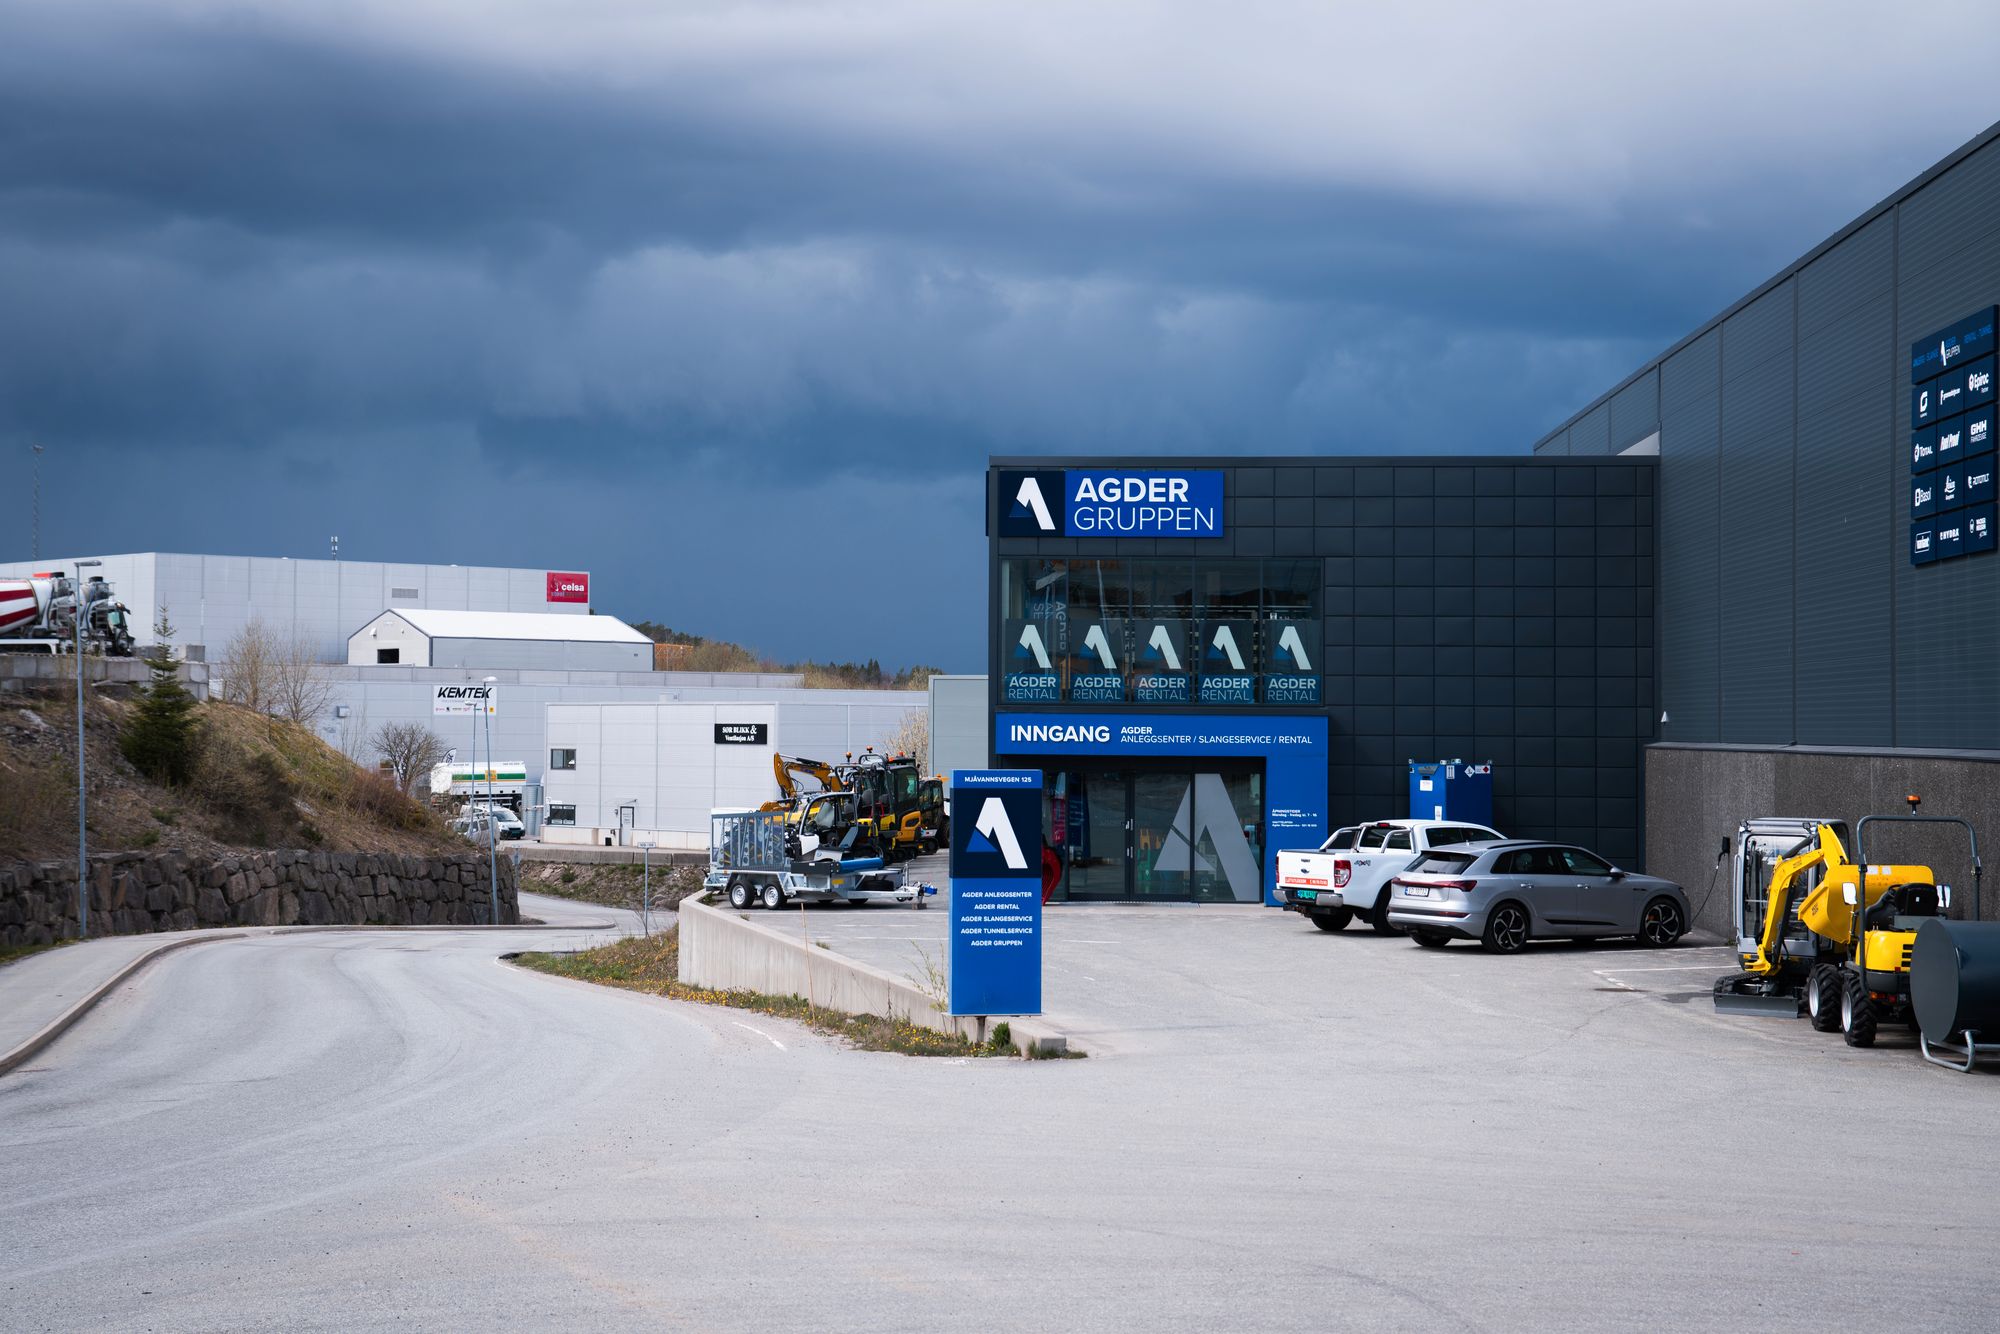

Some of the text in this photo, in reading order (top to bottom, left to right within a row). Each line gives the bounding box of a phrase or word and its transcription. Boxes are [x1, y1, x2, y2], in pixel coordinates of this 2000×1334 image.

[1974, 372, 1990, 390] Epiroc
[1970, 420, 1987, 435] GHH
[1074, 477, 1189, 503] AGDER
[1074, 507, 1214, 531] GRUPPEN
[561, 583, 585, 591] celsa
[1009, 676, 1056, 688] AGDER
[1074, 677, 1121, 688] AGDER
[1138, 677, 1186, 689] AGDER
[1202, 678, 1250, 689] AGDER
[1268, 678, 1316, 690] AGDER
[437, 687, 492, 699] KEMTEK
[1008, 688, 1056, 699] RENTAL
[1073, 689, 1121, 700] RENTAL
[1137, 689, 1186, 700] RENTAL
[1201, 690, 1250, 701] RENTAL
[1267, 690, 1316, 701] RENTAL
[750, 725, 757, 735] &
[1010, 725, 1110, 743] INNGANG
[1120, 726, 1153, 734] AGDER
[1120, 735, 1313, 744] ANLEGGSENTER / SLANGESERVICE / RENTAL
[964, 775, 1020, 783] MJÅVANNSVEGEN
